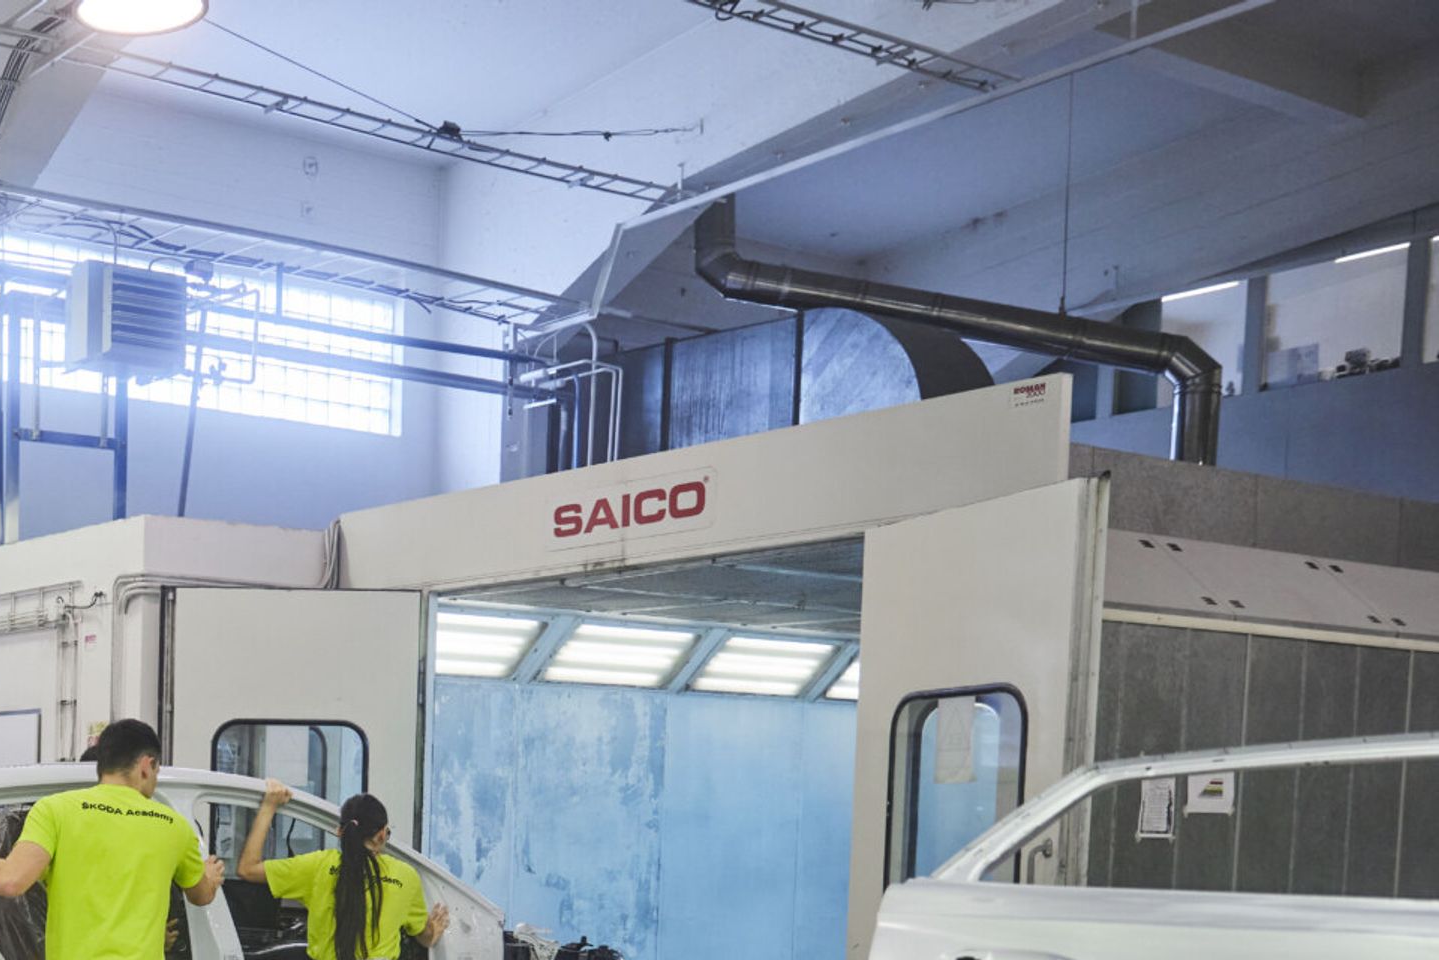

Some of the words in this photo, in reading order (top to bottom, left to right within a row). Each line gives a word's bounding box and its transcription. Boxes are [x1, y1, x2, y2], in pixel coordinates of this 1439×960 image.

[554, 481, 706, 538] SAICO
[81, 801, 123, 816] ŠKODA
[125, 809, 174, 824] Academy
